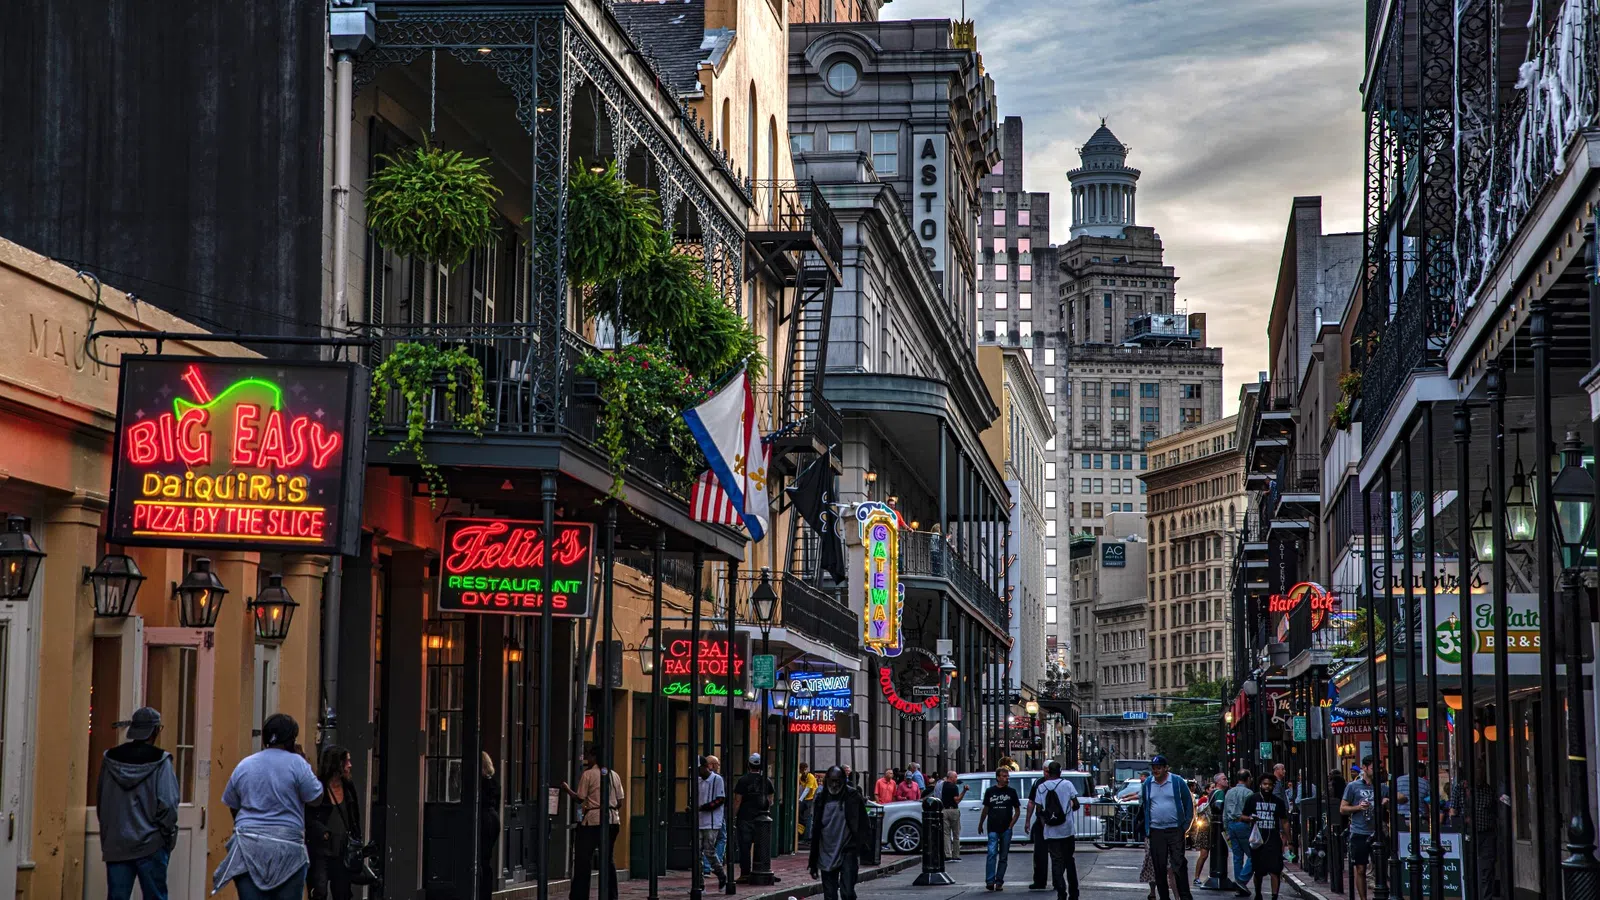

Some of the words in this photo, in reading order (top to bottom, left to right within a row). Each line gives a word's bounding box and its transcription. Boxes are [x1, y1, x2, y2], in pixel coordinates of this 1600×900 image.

[920, 138, 938, 268] ASTOR
[28, 313, 121, 382] MAUM
[128, 407, 210, 465] BIG
[232, 403, 341, 469] EASY
[134, 504, 186, 532] PIZZA
[193, 504, 221, 532] BY
[224, 507, 263, 534] THE
[266, 509, 324, 537] SLICE
[446, 522, 587, 573] Felix's
[1105, 546, 1123, 556] AC
[449, 576, 581, 593] RESTAURNT
[871, 525, 888, 637] GATEWAY
[461, 592, 568, 608] OYSTES
[1311, 591, 1334, 613] ock
[1486, 636, 1516, 647] BR
[1519, 636, 1530, 647] &
[791, 675, 850, 693] GATEWAY
[879, 667, 922, 713] BOURBON
[816, 697, 850, 708] COCKTAILS
[823, 709, 844, 721] BE
[1331, 726, 1344, 735] EW
